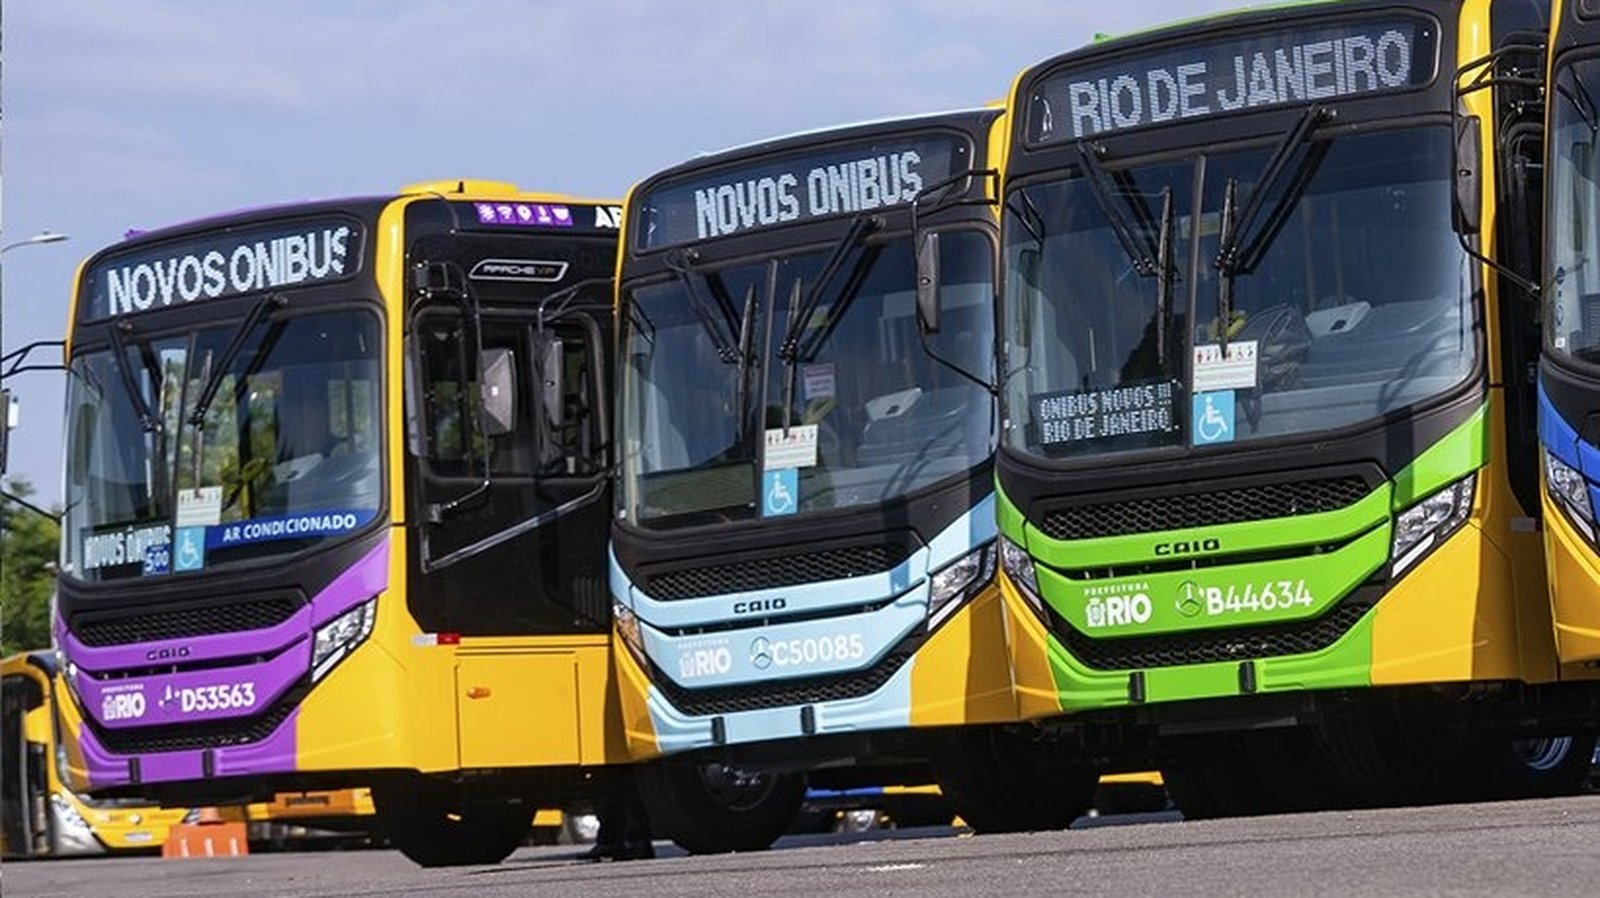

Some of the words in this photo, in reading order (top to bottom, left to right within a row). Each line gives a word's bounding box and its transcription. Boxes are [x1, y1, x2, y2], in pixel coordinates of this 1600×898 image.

[1068, 74, 1141, 137] RIO
[1147, 61, 1210, 122] DE
[1217, 30, 1410, 111] JANEIRO
[694, 173, 800, 239] NOVOS
[807, 150, 923, 215] ONIBUS
[107, 250, 226, 315] NOVOS
[1101, 384, 1154, 413] NOVOS
[1043, 420, 1071, 444] RIO
[1073, 417, 1096, 440] DE
[222, 527, 241, 543] AR
[243, 514, 357, 539] CONDICIONADO
[1106, 593, 1152, 627] RIO
[1206, 579, 1313, 615] B44634
[695, 647, 732, 676] RIO
[772, 633, 864, 666] C50085
[115, 692, 146, 719] RIO
[181, 682, 256, 713] D53563
